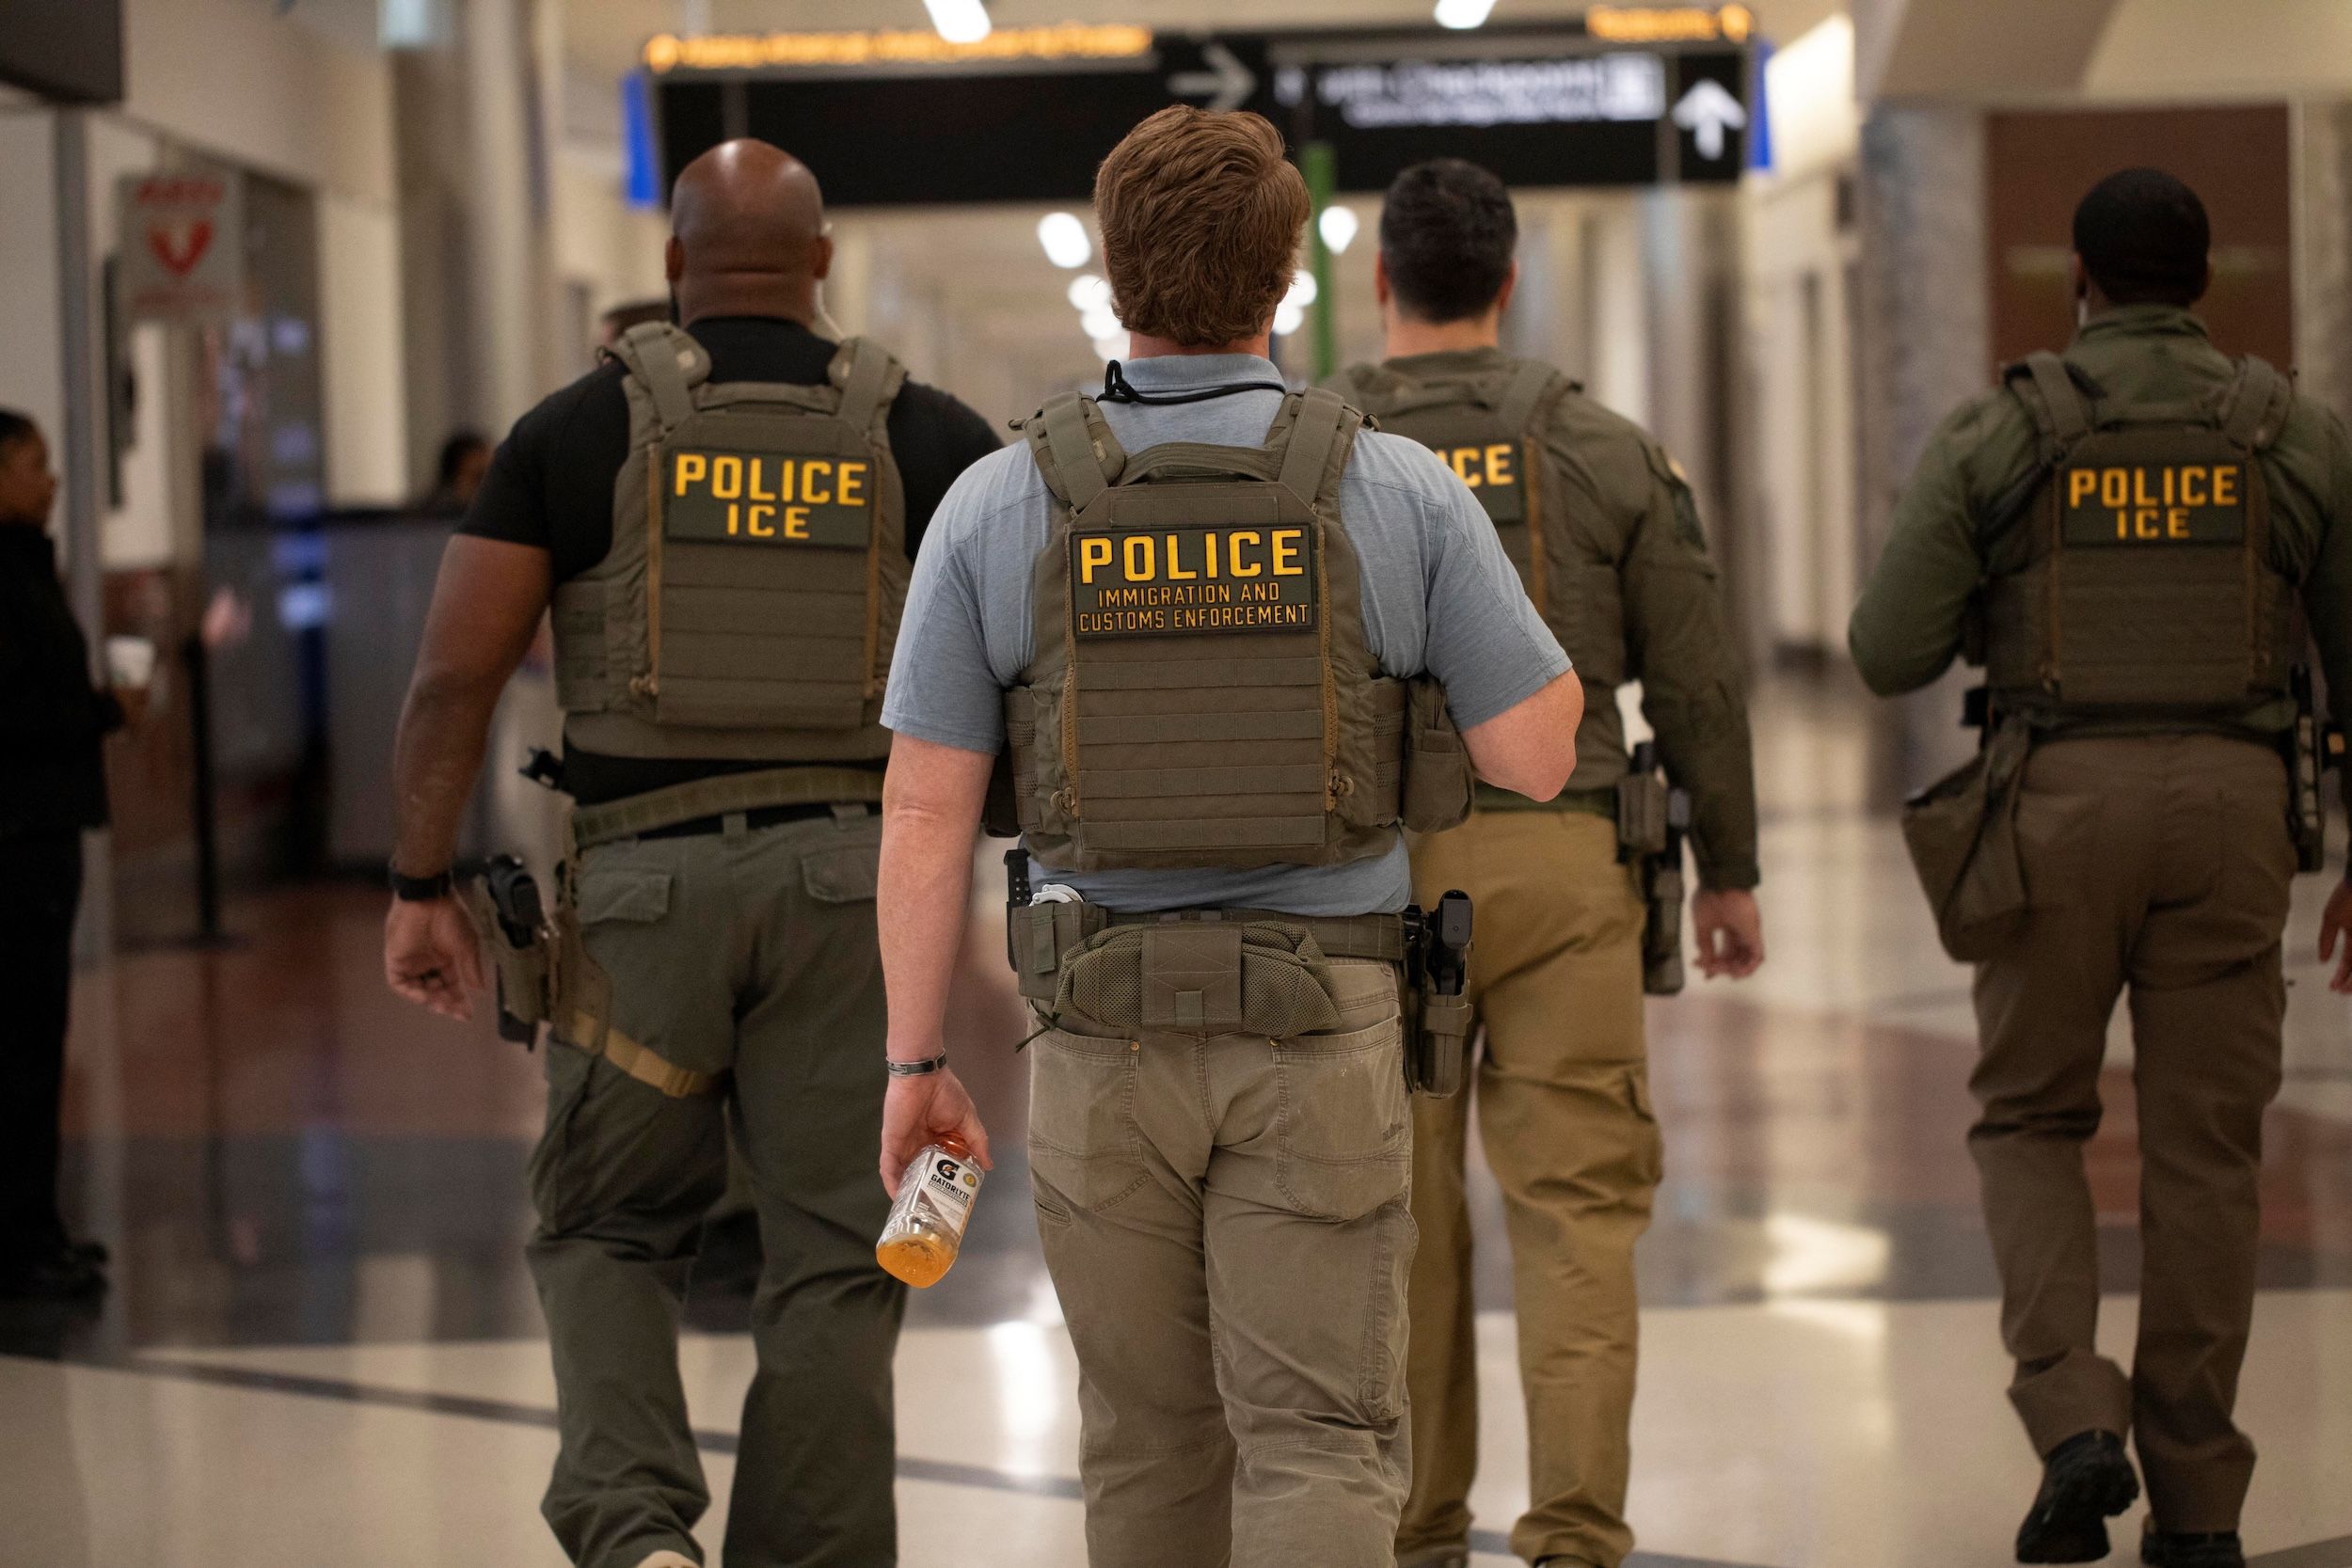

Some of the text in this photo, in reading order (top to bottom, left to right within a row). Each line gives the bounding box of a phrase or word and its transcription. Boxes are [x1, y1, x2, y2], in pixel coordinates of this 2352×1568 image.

[675, 453, 867, 507] POLICE
[2069, 466, 2239, 509] POLICE
[727, 503, 811, 539] ICE
[2116, 507, 2191, 540] ICE
[1080, 529, 1304, 584] POLICE
[1098, 581, 1280, 609] IMMIGRATION AND
[1078, 603, 1309, 633] CUSTOMS ENFORCEMENT
[936, 1159, 961, 1181] G
[930, 1173, 972, 1202] GATORLYTE
